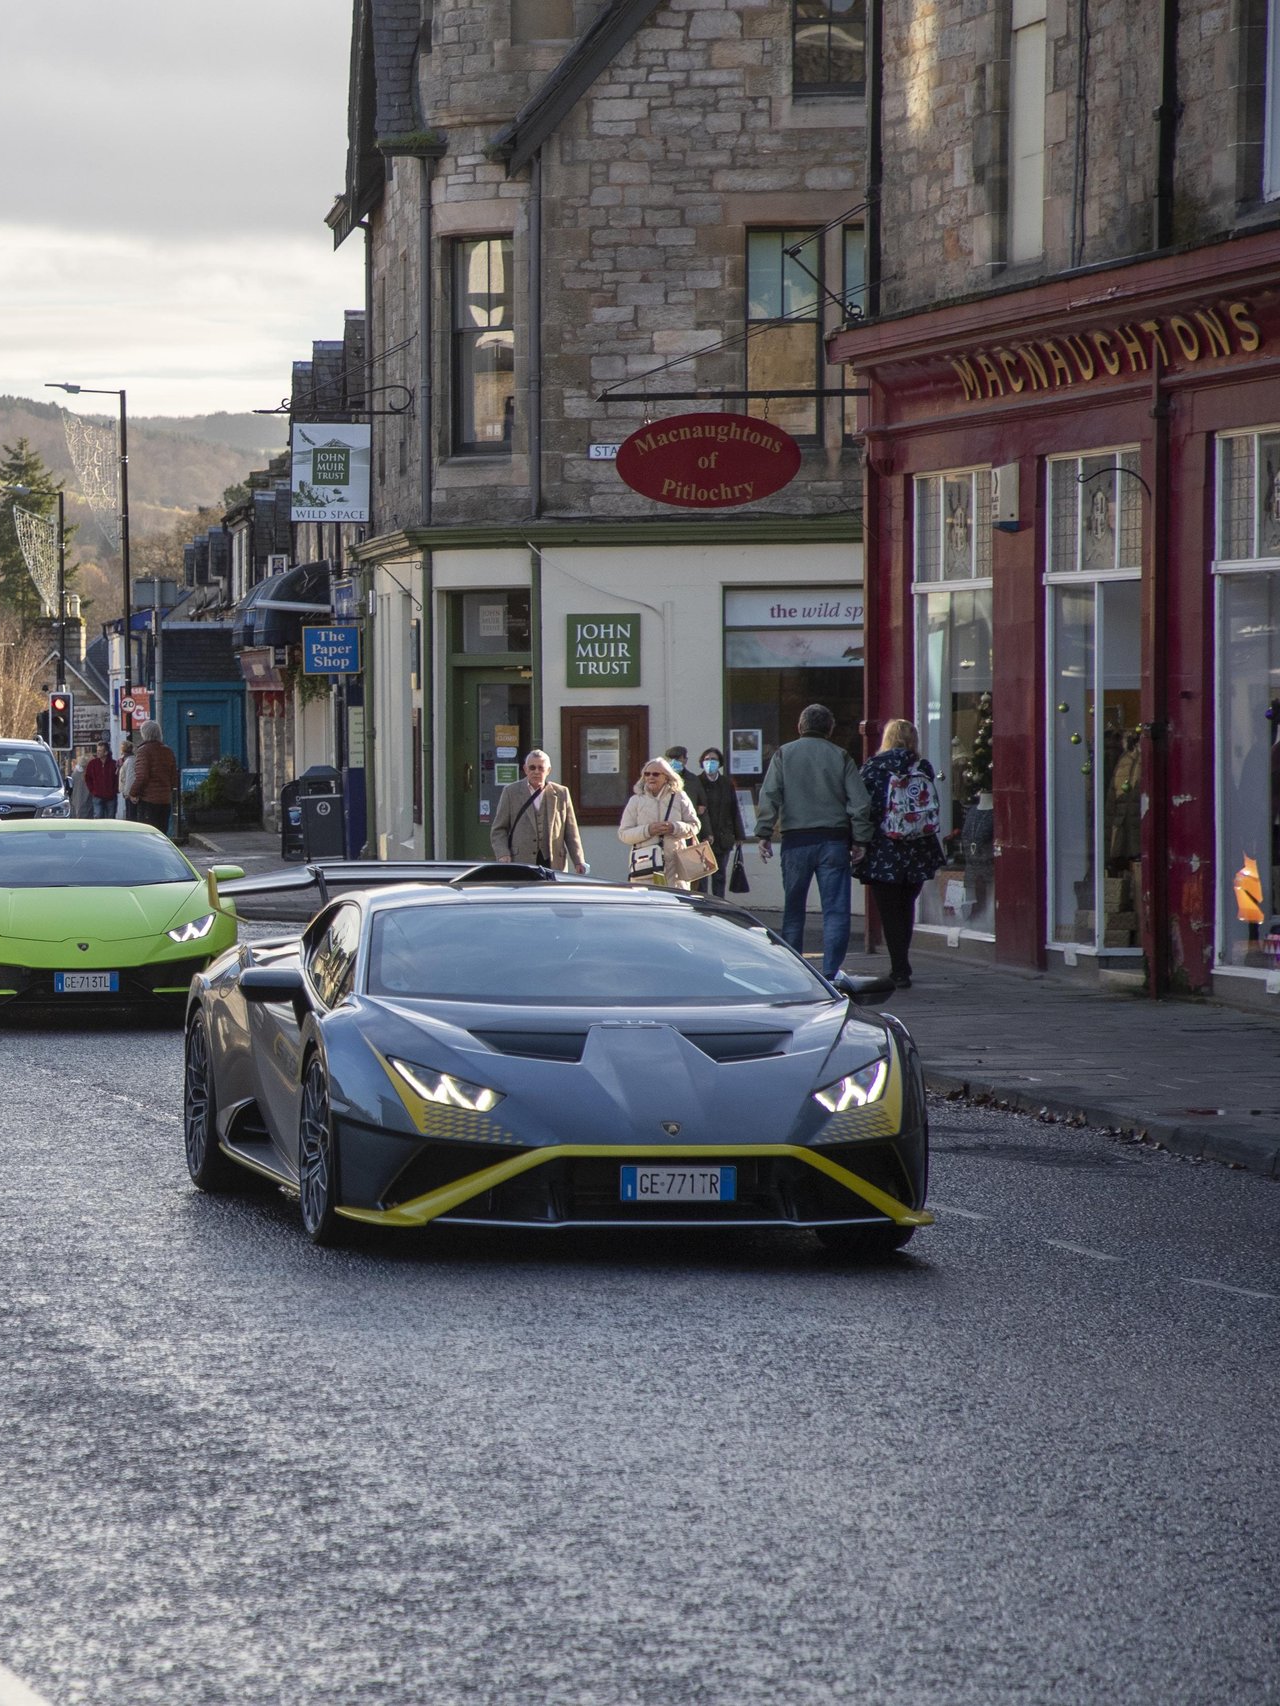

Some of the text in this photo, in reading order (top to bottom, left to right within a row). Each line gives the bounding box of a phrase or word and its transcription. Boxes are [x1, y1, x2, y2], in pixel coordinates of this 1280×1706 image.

[951, 302, 1260, 401] MACNAUGHTONS
[633, 422, 784, 456] Macnaughtons
[595, 446, 618, 456] STA
[317, 453, 346, 463] JOHN
[697, 451, 719, 469] of
[316, 462, 345, 471] MUIR
[317, 472, 345, 480] TRUST
[661, 478, 754, 501] Pitlochry
[295, 510, 365, 519] WILD SPACE
[770, 604, 797, 618] the
[802, 602, 841, 618] wild
[317, 631, 345, 641] The
[576, 623, 631, 643] JOHN
[311, 644, 352, 656] Paper
[576, 642, 631, 658] MUIR
[313, 656, 350, 669] Shop
[576, 661, 631, 675] TRUST
[122, 700, 134, 708] 20
